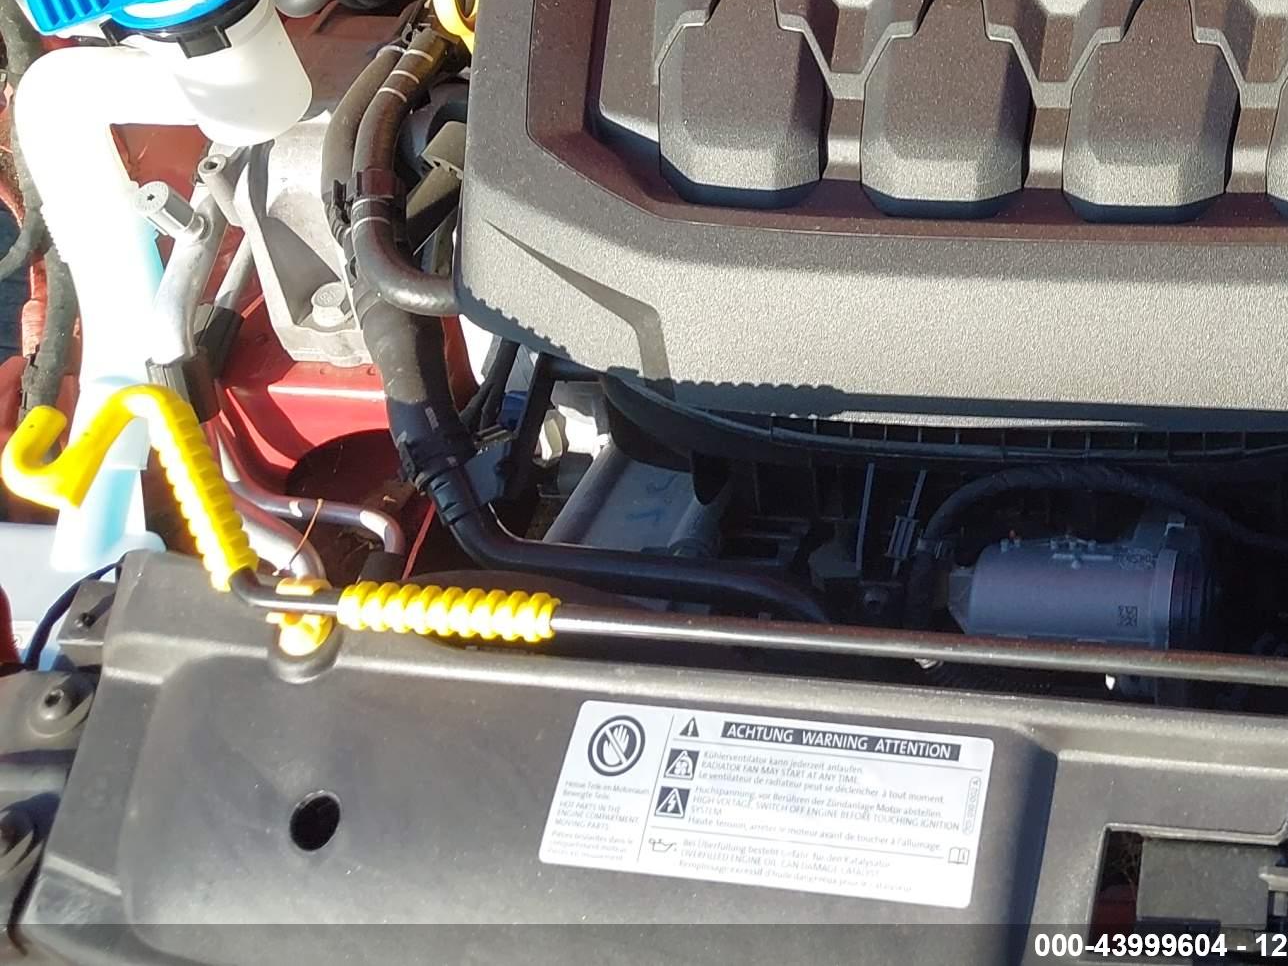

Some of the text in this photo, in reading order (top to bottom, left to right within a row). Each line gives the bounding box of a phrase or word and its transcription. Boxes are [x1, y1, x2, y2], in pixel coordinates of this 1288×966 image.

[726, 723, 951, 759] ACHTUNG WARNING ATTENTION
